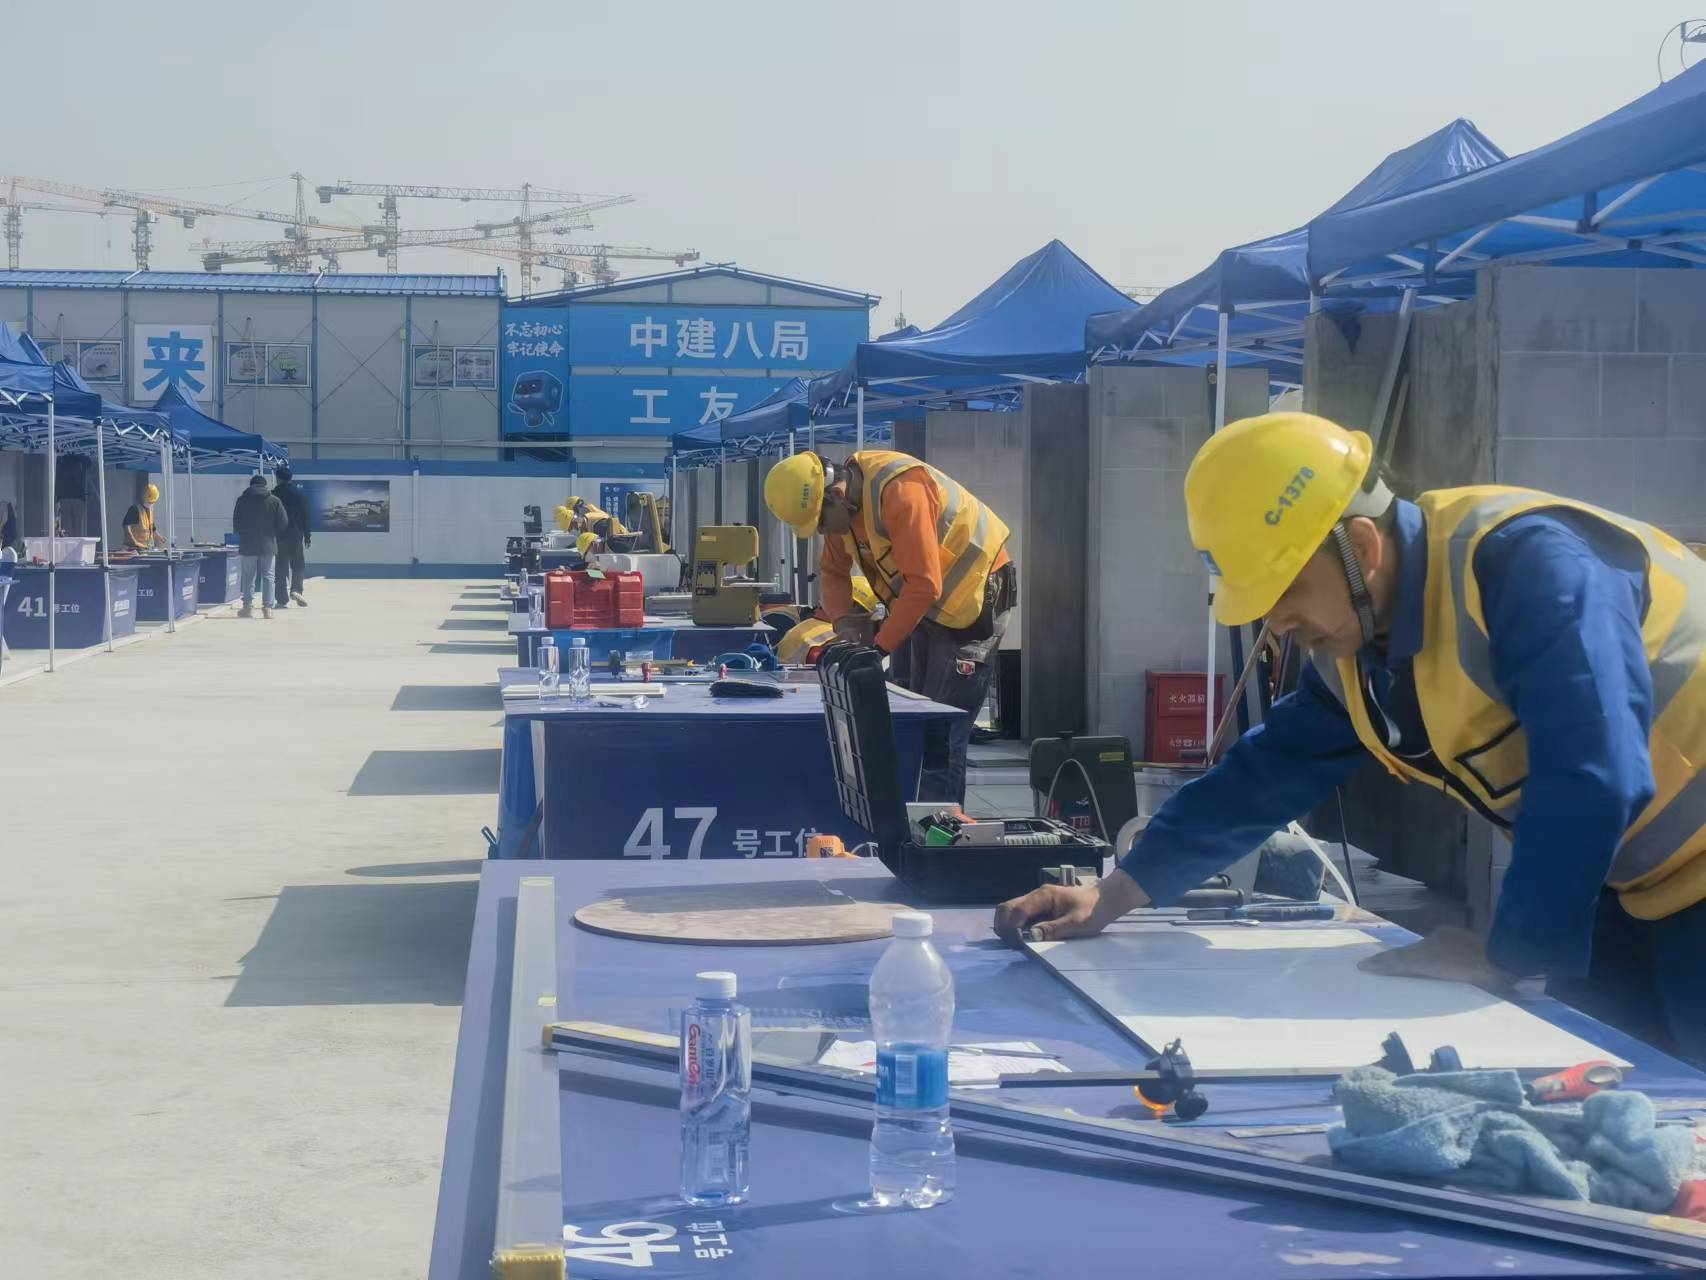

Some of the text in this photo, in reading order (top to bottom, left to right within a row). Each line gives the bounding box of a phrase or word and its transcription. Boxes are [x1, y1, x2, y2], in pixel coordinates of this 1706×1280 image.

[505, 321, 564, 337] 不忘初心
[506, 340, 565, 358] 牢记使命
[630, 316, 809, 360] 中建八局
[143, 331, 206, 394] 来
[630, 386, 781, 425] 工友
[16, 596, 48, 617] 41
[623, 806, 718, 860] 47
[562, 1219, 734, 1267] 46 号工位
